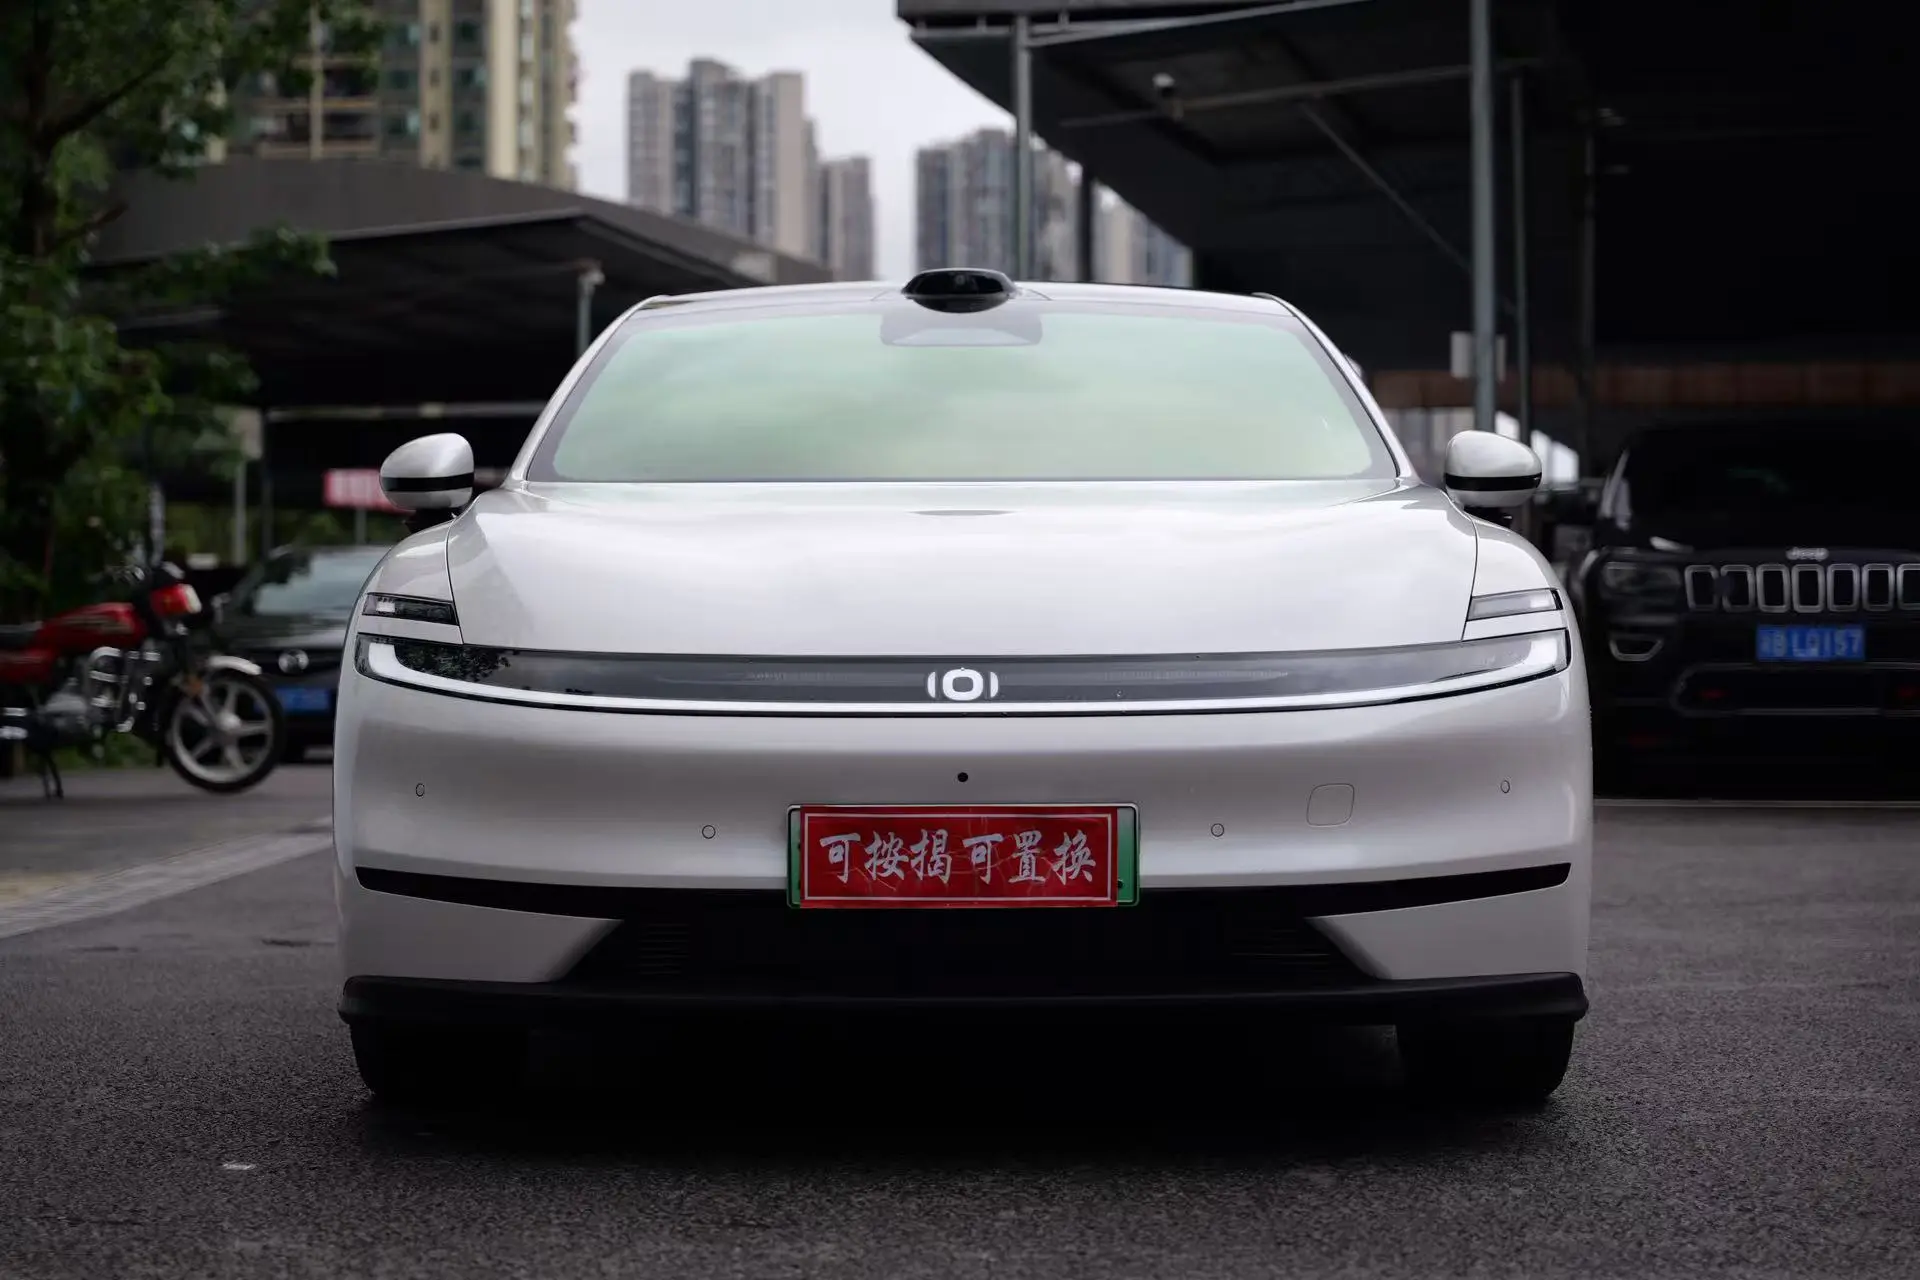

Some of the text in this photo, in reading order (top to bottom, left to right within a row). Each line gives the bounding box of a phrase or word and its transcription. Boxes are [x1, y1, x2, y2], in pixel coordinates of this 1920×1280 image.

[820, 828, 1097, 885] 可按揭可置换
